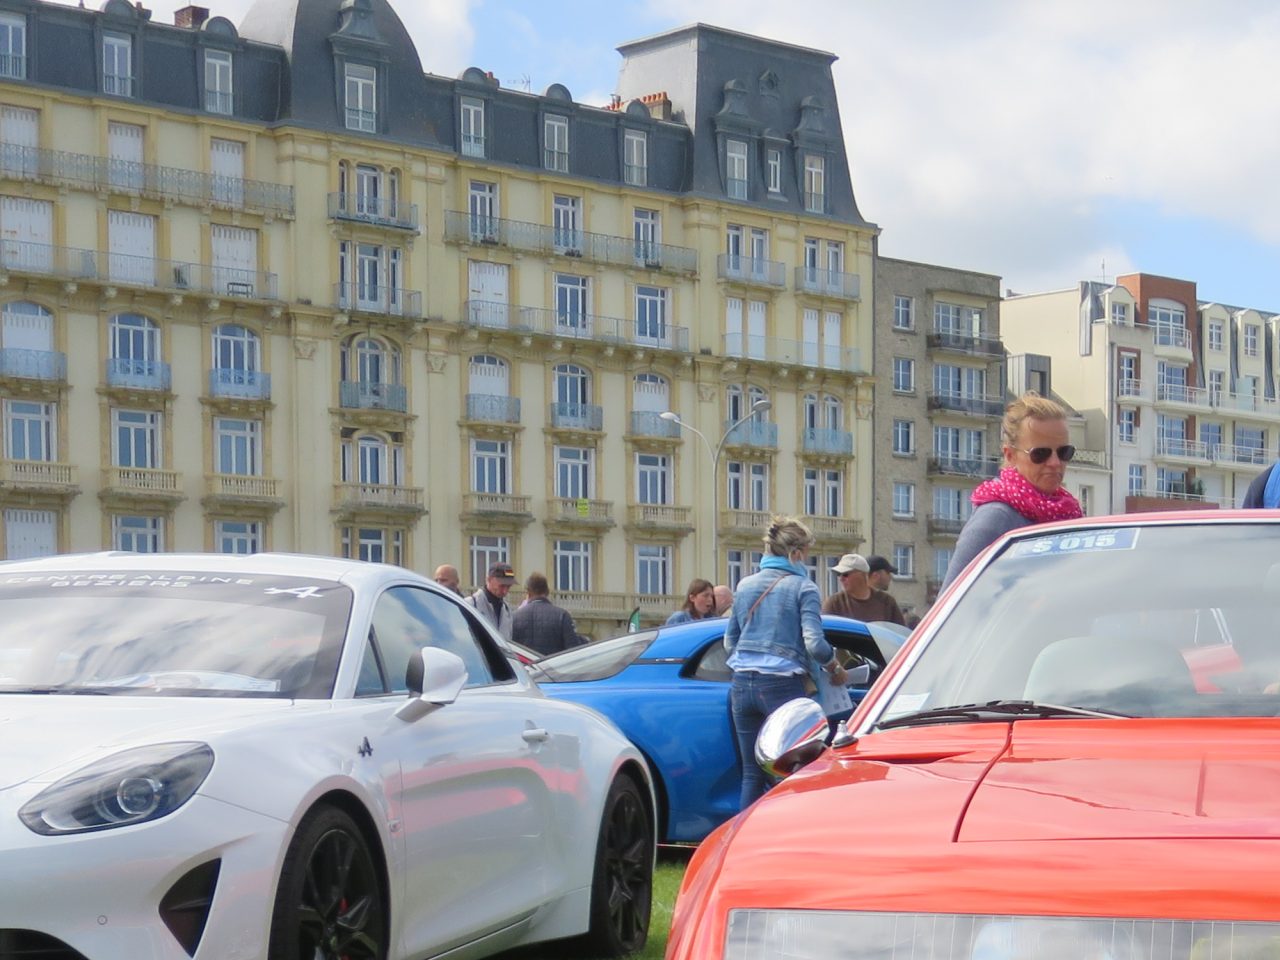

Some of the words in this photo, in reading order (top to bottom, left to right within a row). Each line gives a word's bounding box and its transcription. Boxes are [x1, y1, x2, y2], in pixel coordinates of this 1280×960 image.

[1032, 540, 1053, 553] S
[1059, 535, 1116, 549] 015
[6, 574, 129, 584] CENTRE
[134, 574, 256, 585] ALPINE
